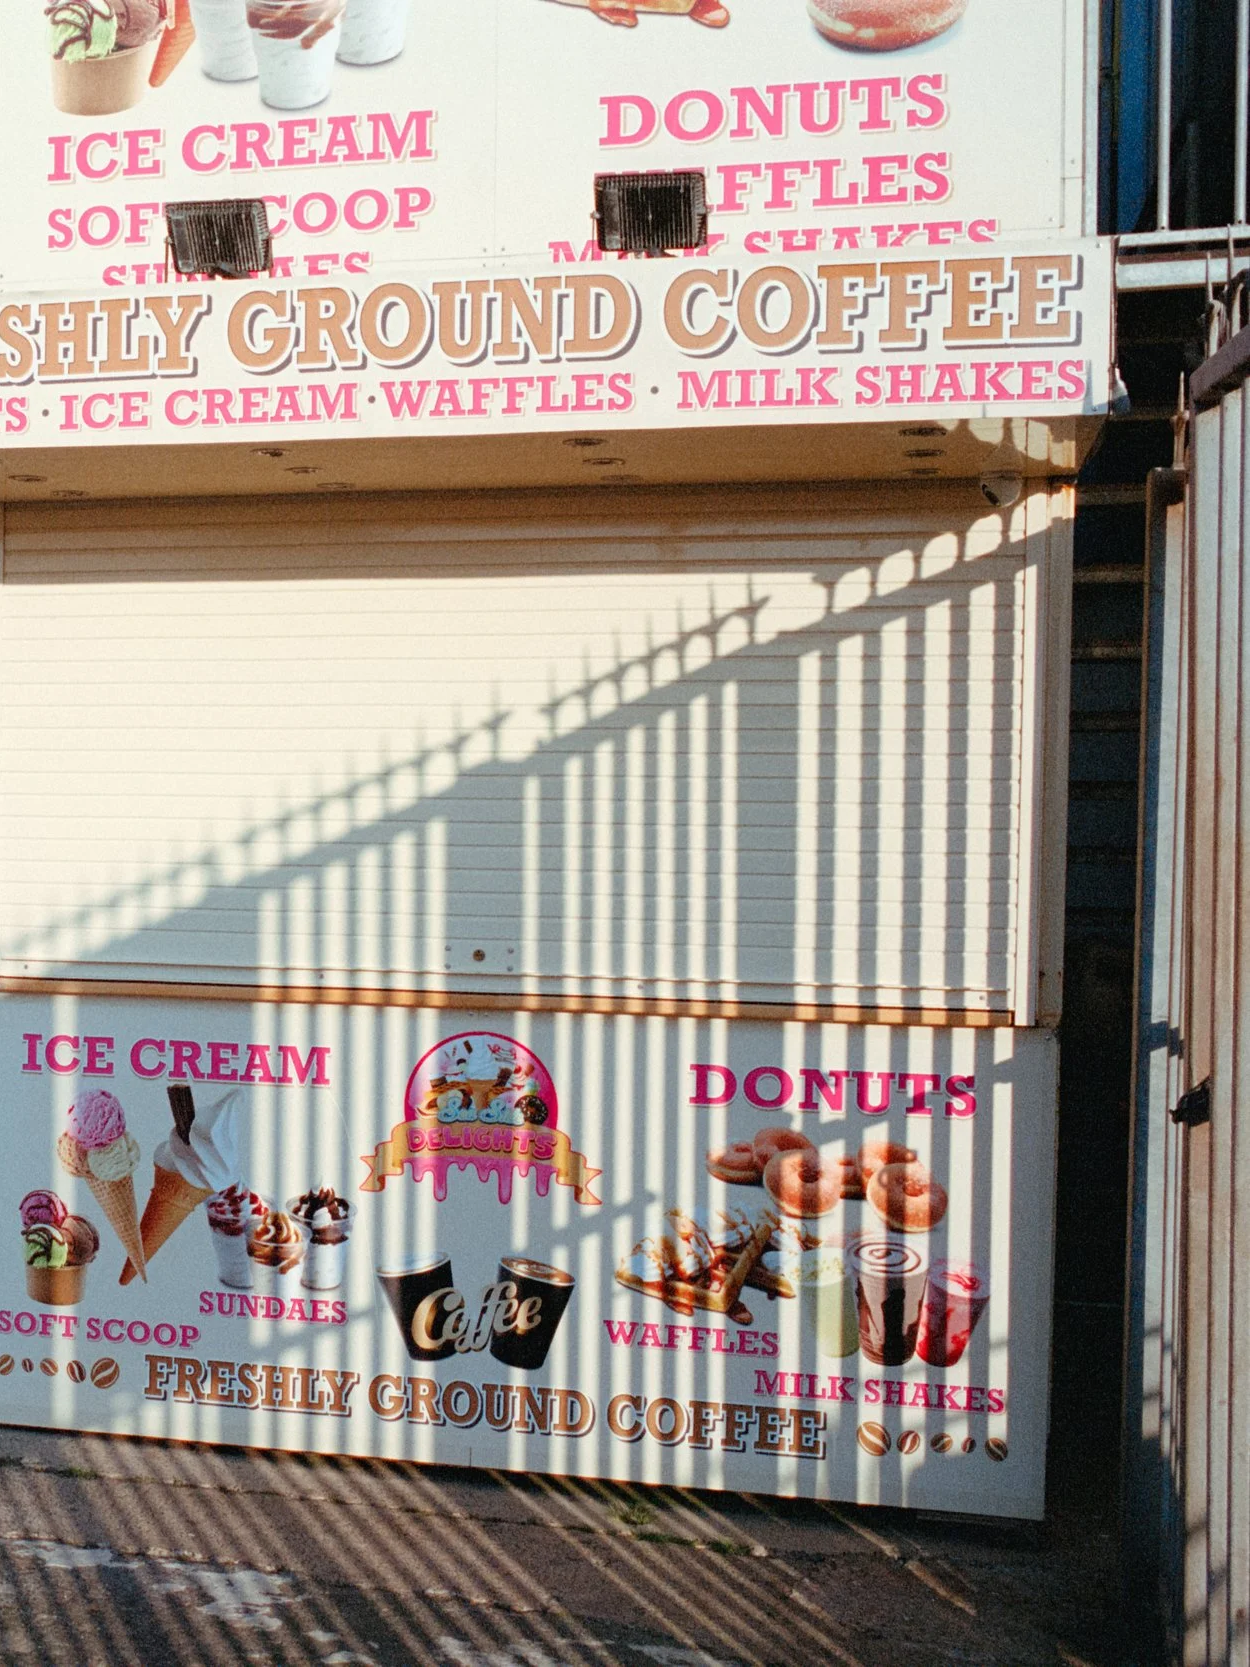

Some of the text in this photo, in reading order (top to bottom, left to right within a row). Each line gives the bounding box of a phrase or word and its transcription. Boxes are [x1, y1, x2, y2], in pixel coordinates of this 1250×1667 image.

[599, 73, 946, 147] DONUTS
[47, 109, 434, 182] ICE CREAM
[595, 151, 950, 214] FFLES
[48, 202, 167, 249] SOF
[227, 272, 639, 372] GROUND
[663, 254, 1076, 351] COFFEE
[59, 391, 150, 431] ICE
[164, 382, 359, 427] CREAM
[380, 372, 635, 419] WAFFLES
[676, 366, 840, 411] MILK
[854, 359, 1087, 406] SHAKES
[22, 1033, 332, 1087] ICE CREAM
[688, 1062, 979, 1119] DONUTS
[406, 1125, 558, 1160] DELIGHTS
[85, 1317, 201, 1349] SCOOP
[198, 1290, 349, 1326] SUNDAES
[411, 1280, 543, 1354] Coffee
[603, 1319, 781, 1359] WAFFLES
[143, 1354, 826, 1458] FRESHLY GROUND COFFEE
[754, 1369, 1008, 1415] MILK SHAKES
